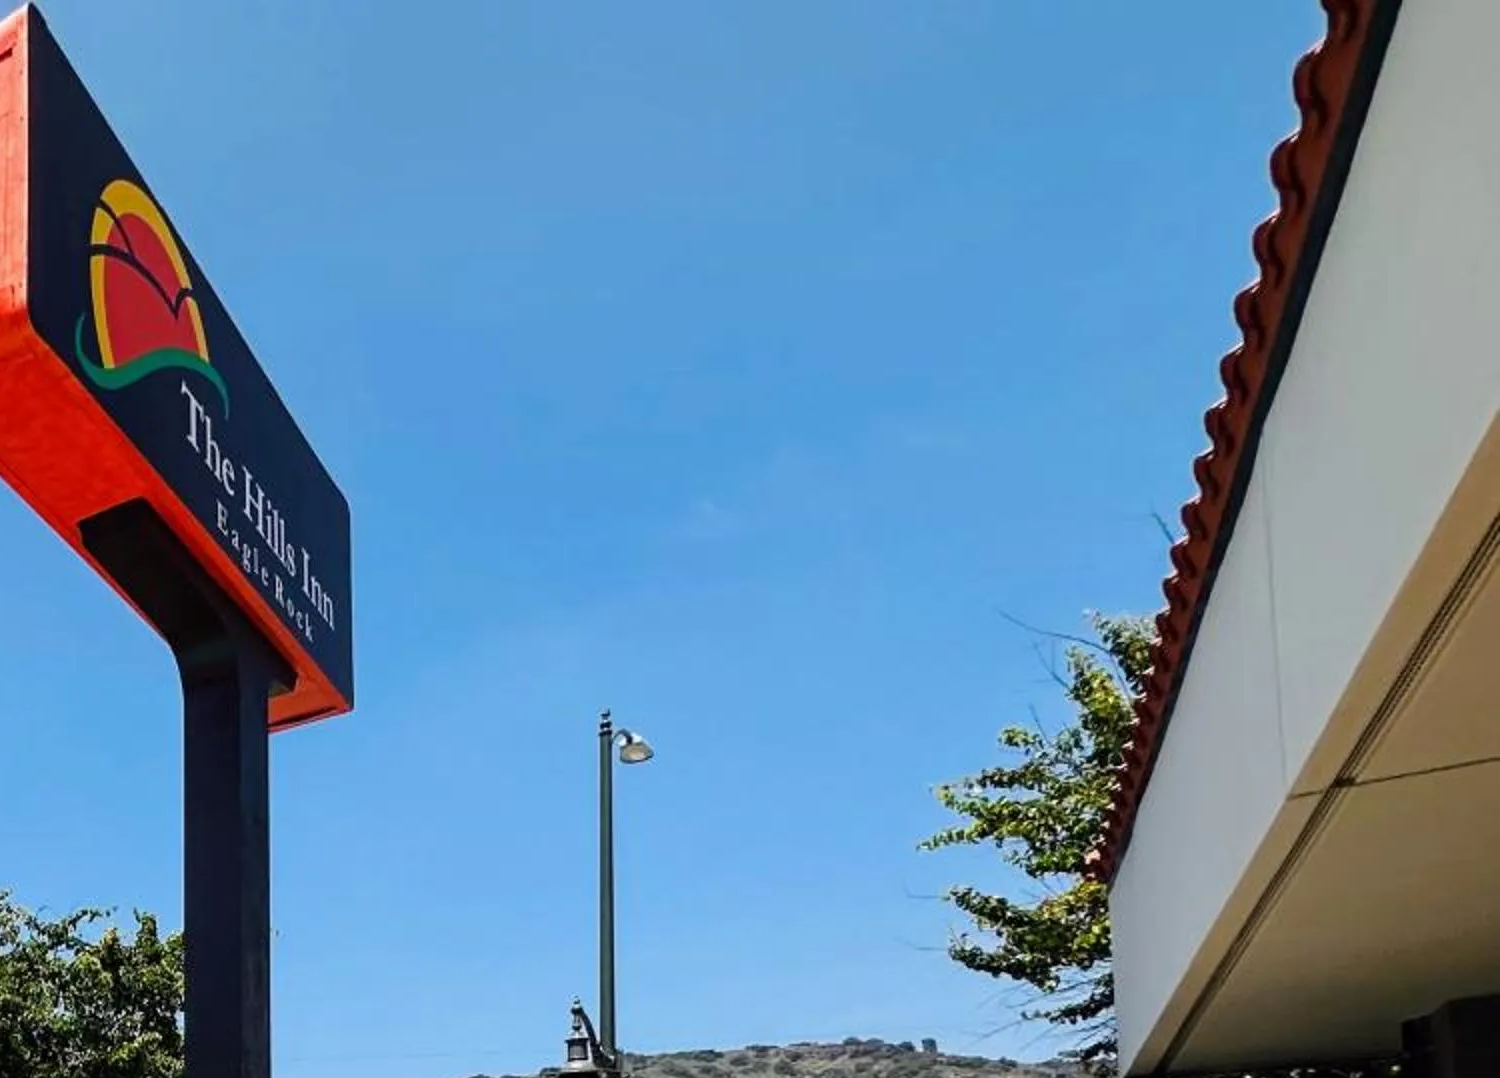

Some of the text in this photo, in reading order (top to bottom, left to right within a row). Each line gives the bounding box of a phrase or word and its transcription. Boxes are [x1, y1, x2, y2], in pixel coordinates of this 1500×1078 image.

[181, 378, 335, 631] The Hills Inn
[216, 498, 313, 642] Eagle Rock
